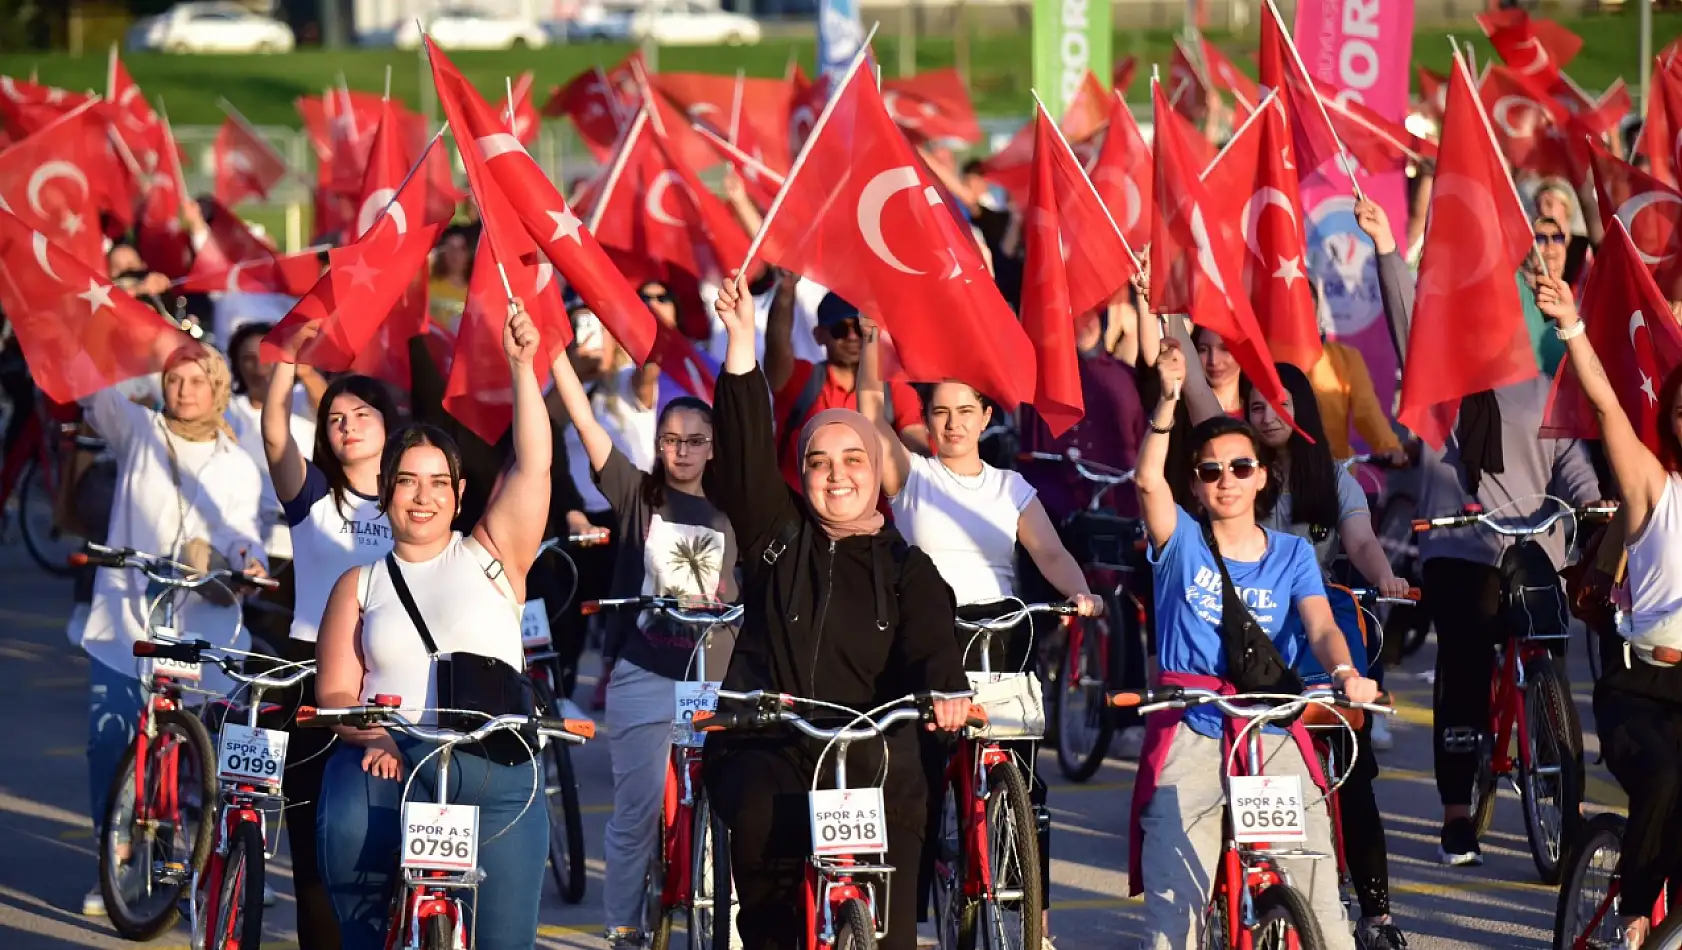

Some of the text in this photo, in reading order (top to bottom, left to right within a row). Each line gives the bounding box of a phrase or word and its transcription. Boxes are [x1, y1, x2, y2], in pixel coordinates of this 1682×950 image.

[339, 519, 393, 541] ATLANT
[679, 698, 709, 707] SPOR
[226, 742, 257, 754] SPOR
[227, 754, 277, 776] 0199
[1236, 797, 1270, 807] SPOR
[815, 810, 850, 821] SPOR
[1241, 809, 1298, 828] 0562
[408, 823, 444, 836] SPOR
[821, 822, 877, 842] 0918
[409, 837, 469, 859] 0796
